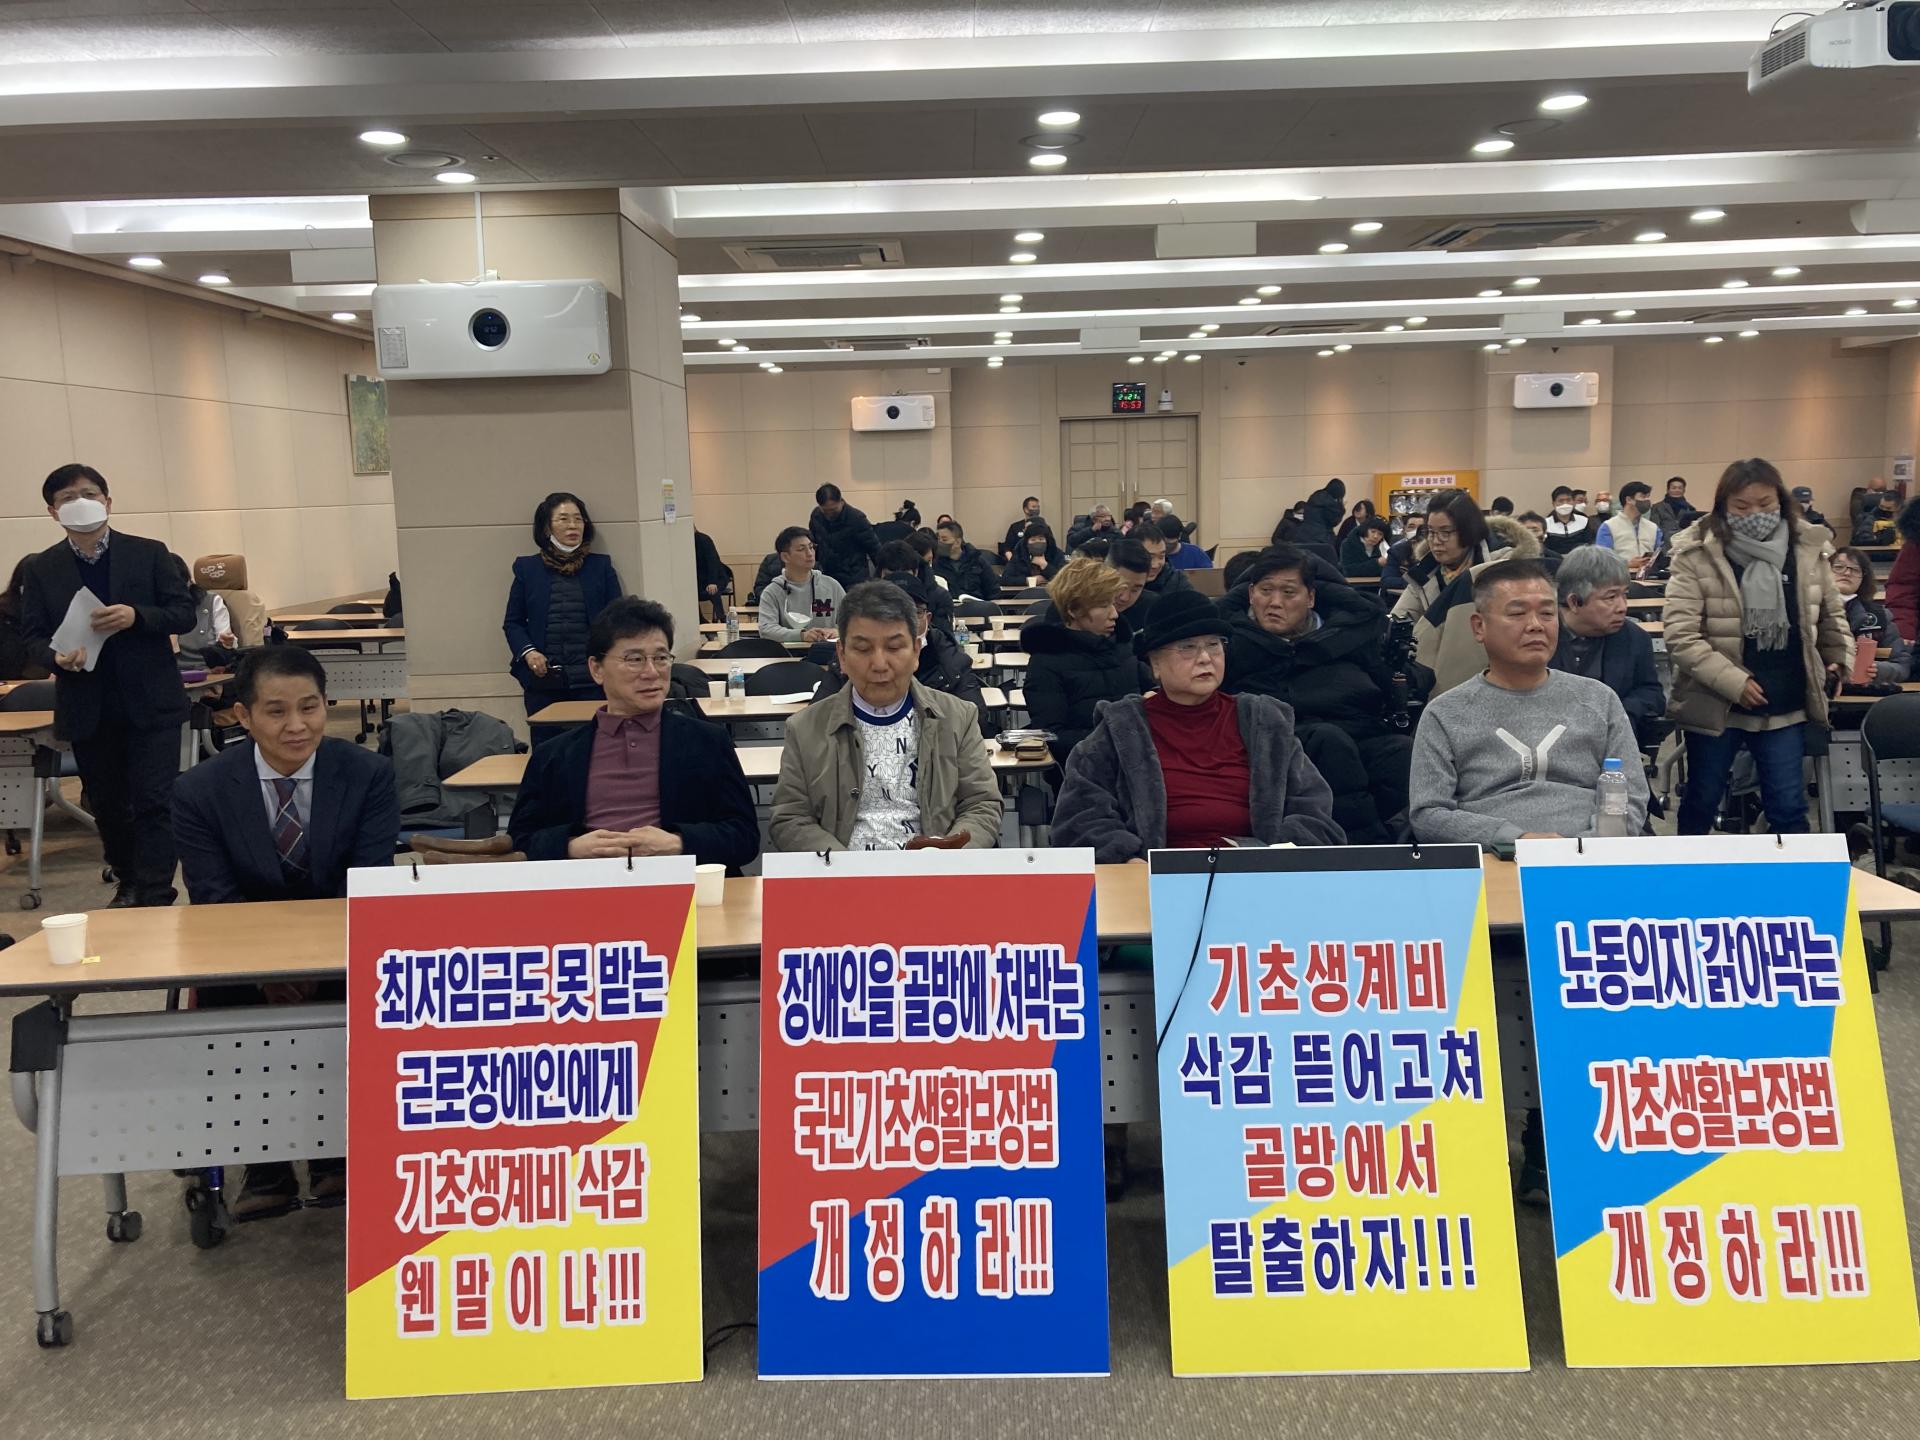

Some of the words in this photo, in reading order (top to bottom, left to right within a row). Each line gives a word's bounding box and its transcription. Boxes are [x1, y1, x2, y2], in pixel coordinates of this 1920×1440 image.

[380, 950, 546, 1025] 최저임금도
[555, 948, 590, 1020] 못
[598, 945, 665, 1017] 받는
[781, 947, 895, 1041] 장애인을
[903, 948, 988, 1039] 골방에
[995, 946, 1081, 1036] 처박는
[1207, 941, 1448, 1014] 기초생계비
[1560, 921, 1698, 1006] 노동의지
[1699, 920, 1842, 1003] 갉아먹는
[401, 1045, 634, 1125] 근로장애인에게
[1179, 1034, 1273, 1106] 삭감
[1293, 1029, 1484, 1104] 뜯어고쳐
[1593, 1060, 1840, 1149] 기초생활보장법
[799, 1071, 1055, 1167] 국민기초생활보장법
[400, 1151, 567, 1228] 기초생계비
[577, 1147, 645, 1220] 삭감
[1244, 1123, 1440, 1198] 골방에서
[1210, 1216, 1476, 1296] 탈출하자!!!
